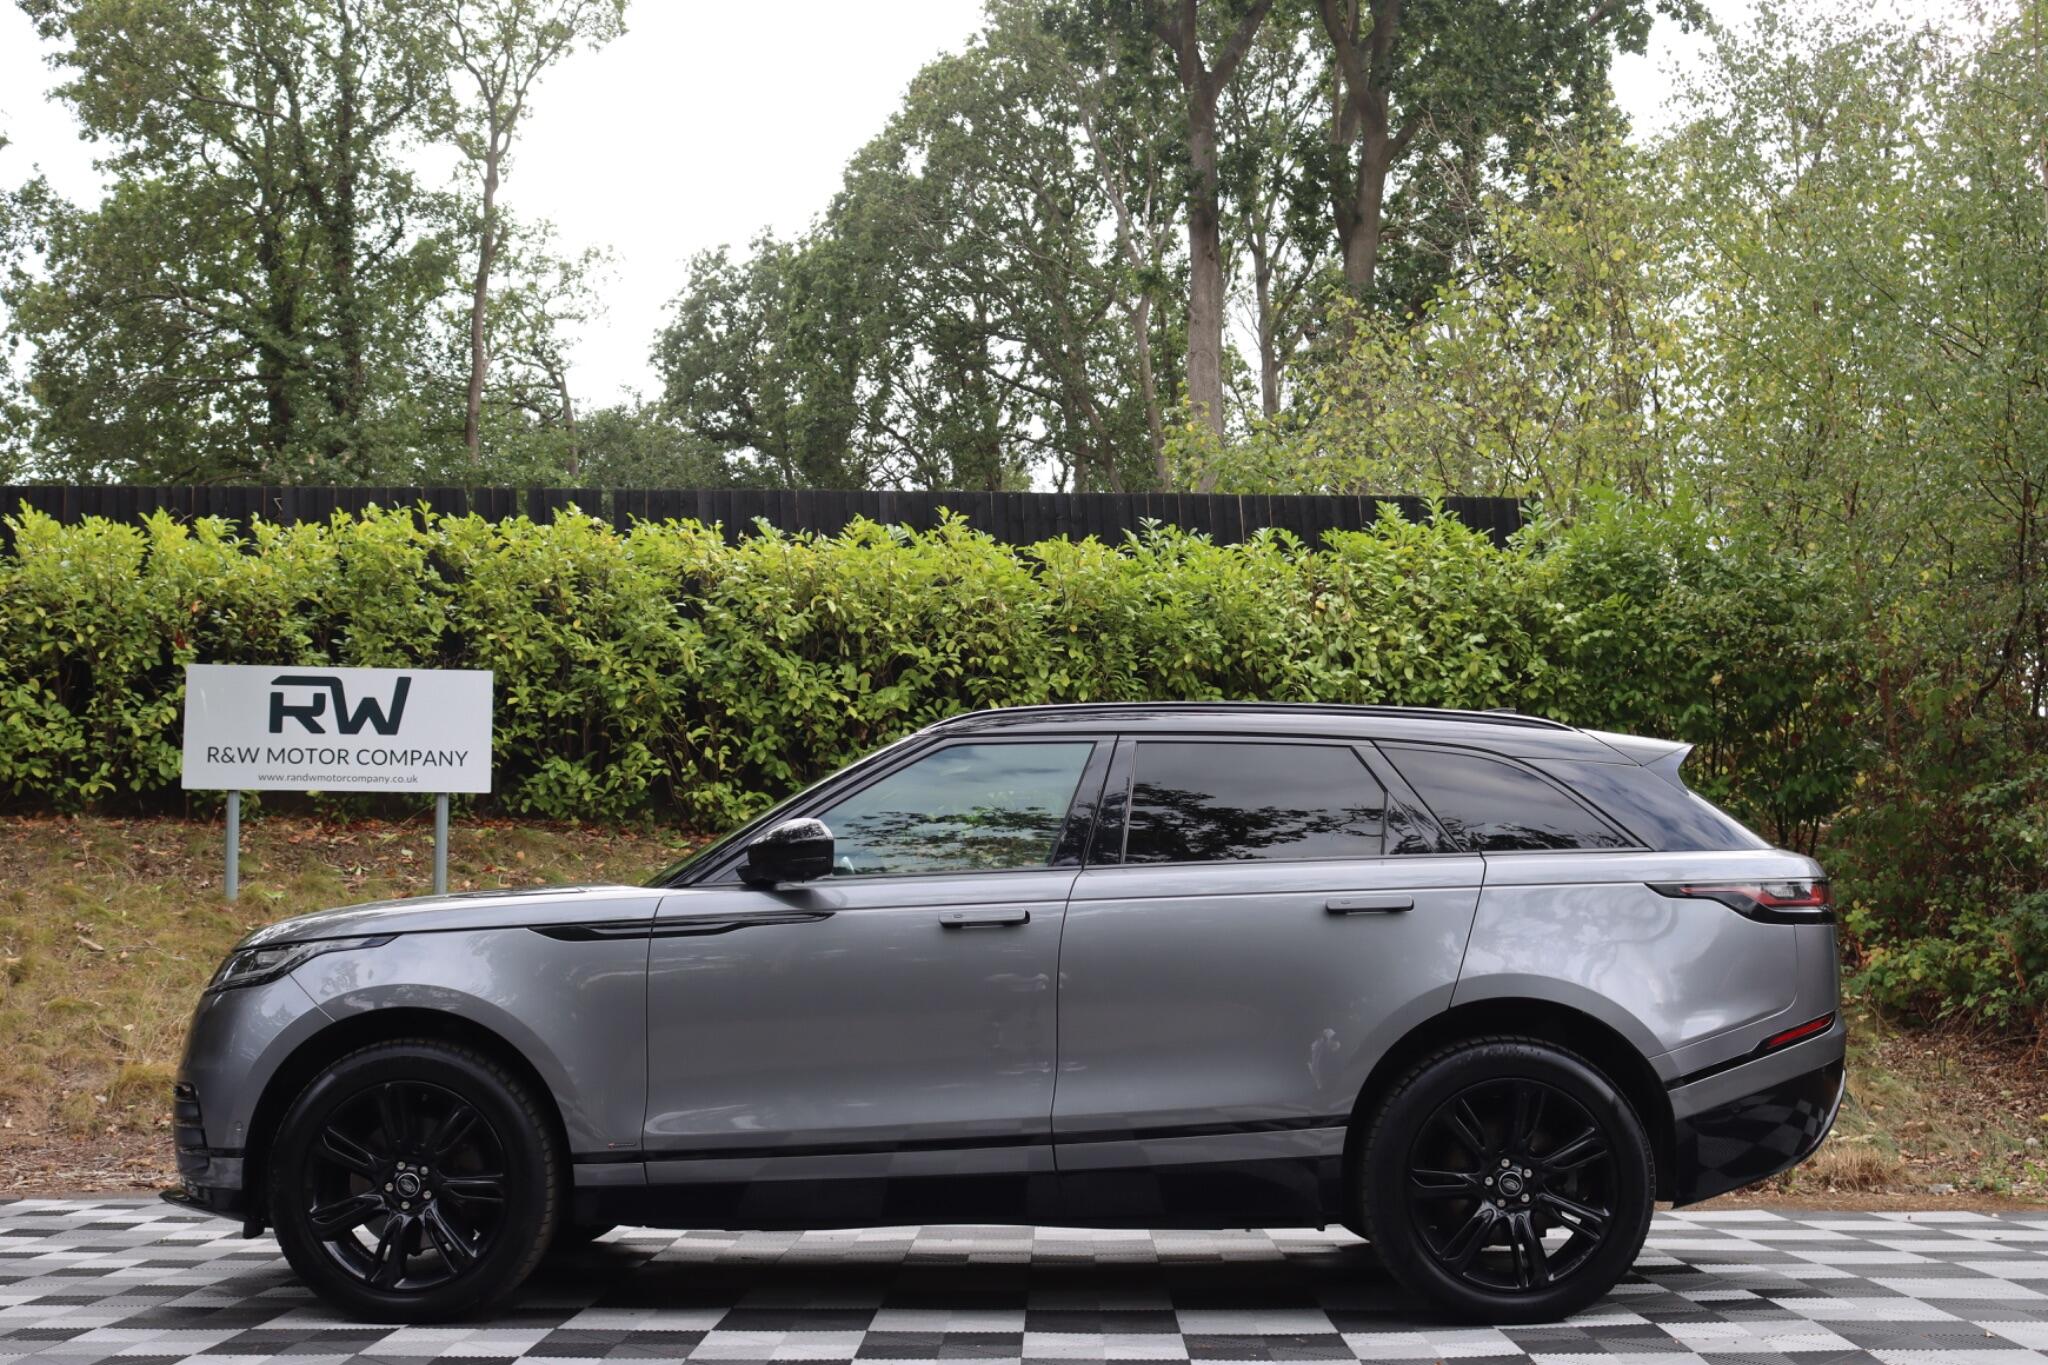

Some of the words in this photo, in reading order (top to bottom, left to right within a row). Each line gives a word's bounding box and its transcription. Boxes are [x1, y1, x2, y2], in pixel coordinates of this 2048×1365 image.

[269, 675, 412, 735] RW
[206, 746, 260, 763] R&W
[266, 747, 349, 765] MOTOR
[356, 749, 469, 767] COMPANY
[258, 773, 418, 784] www.randwmotorcompany.co.uk
